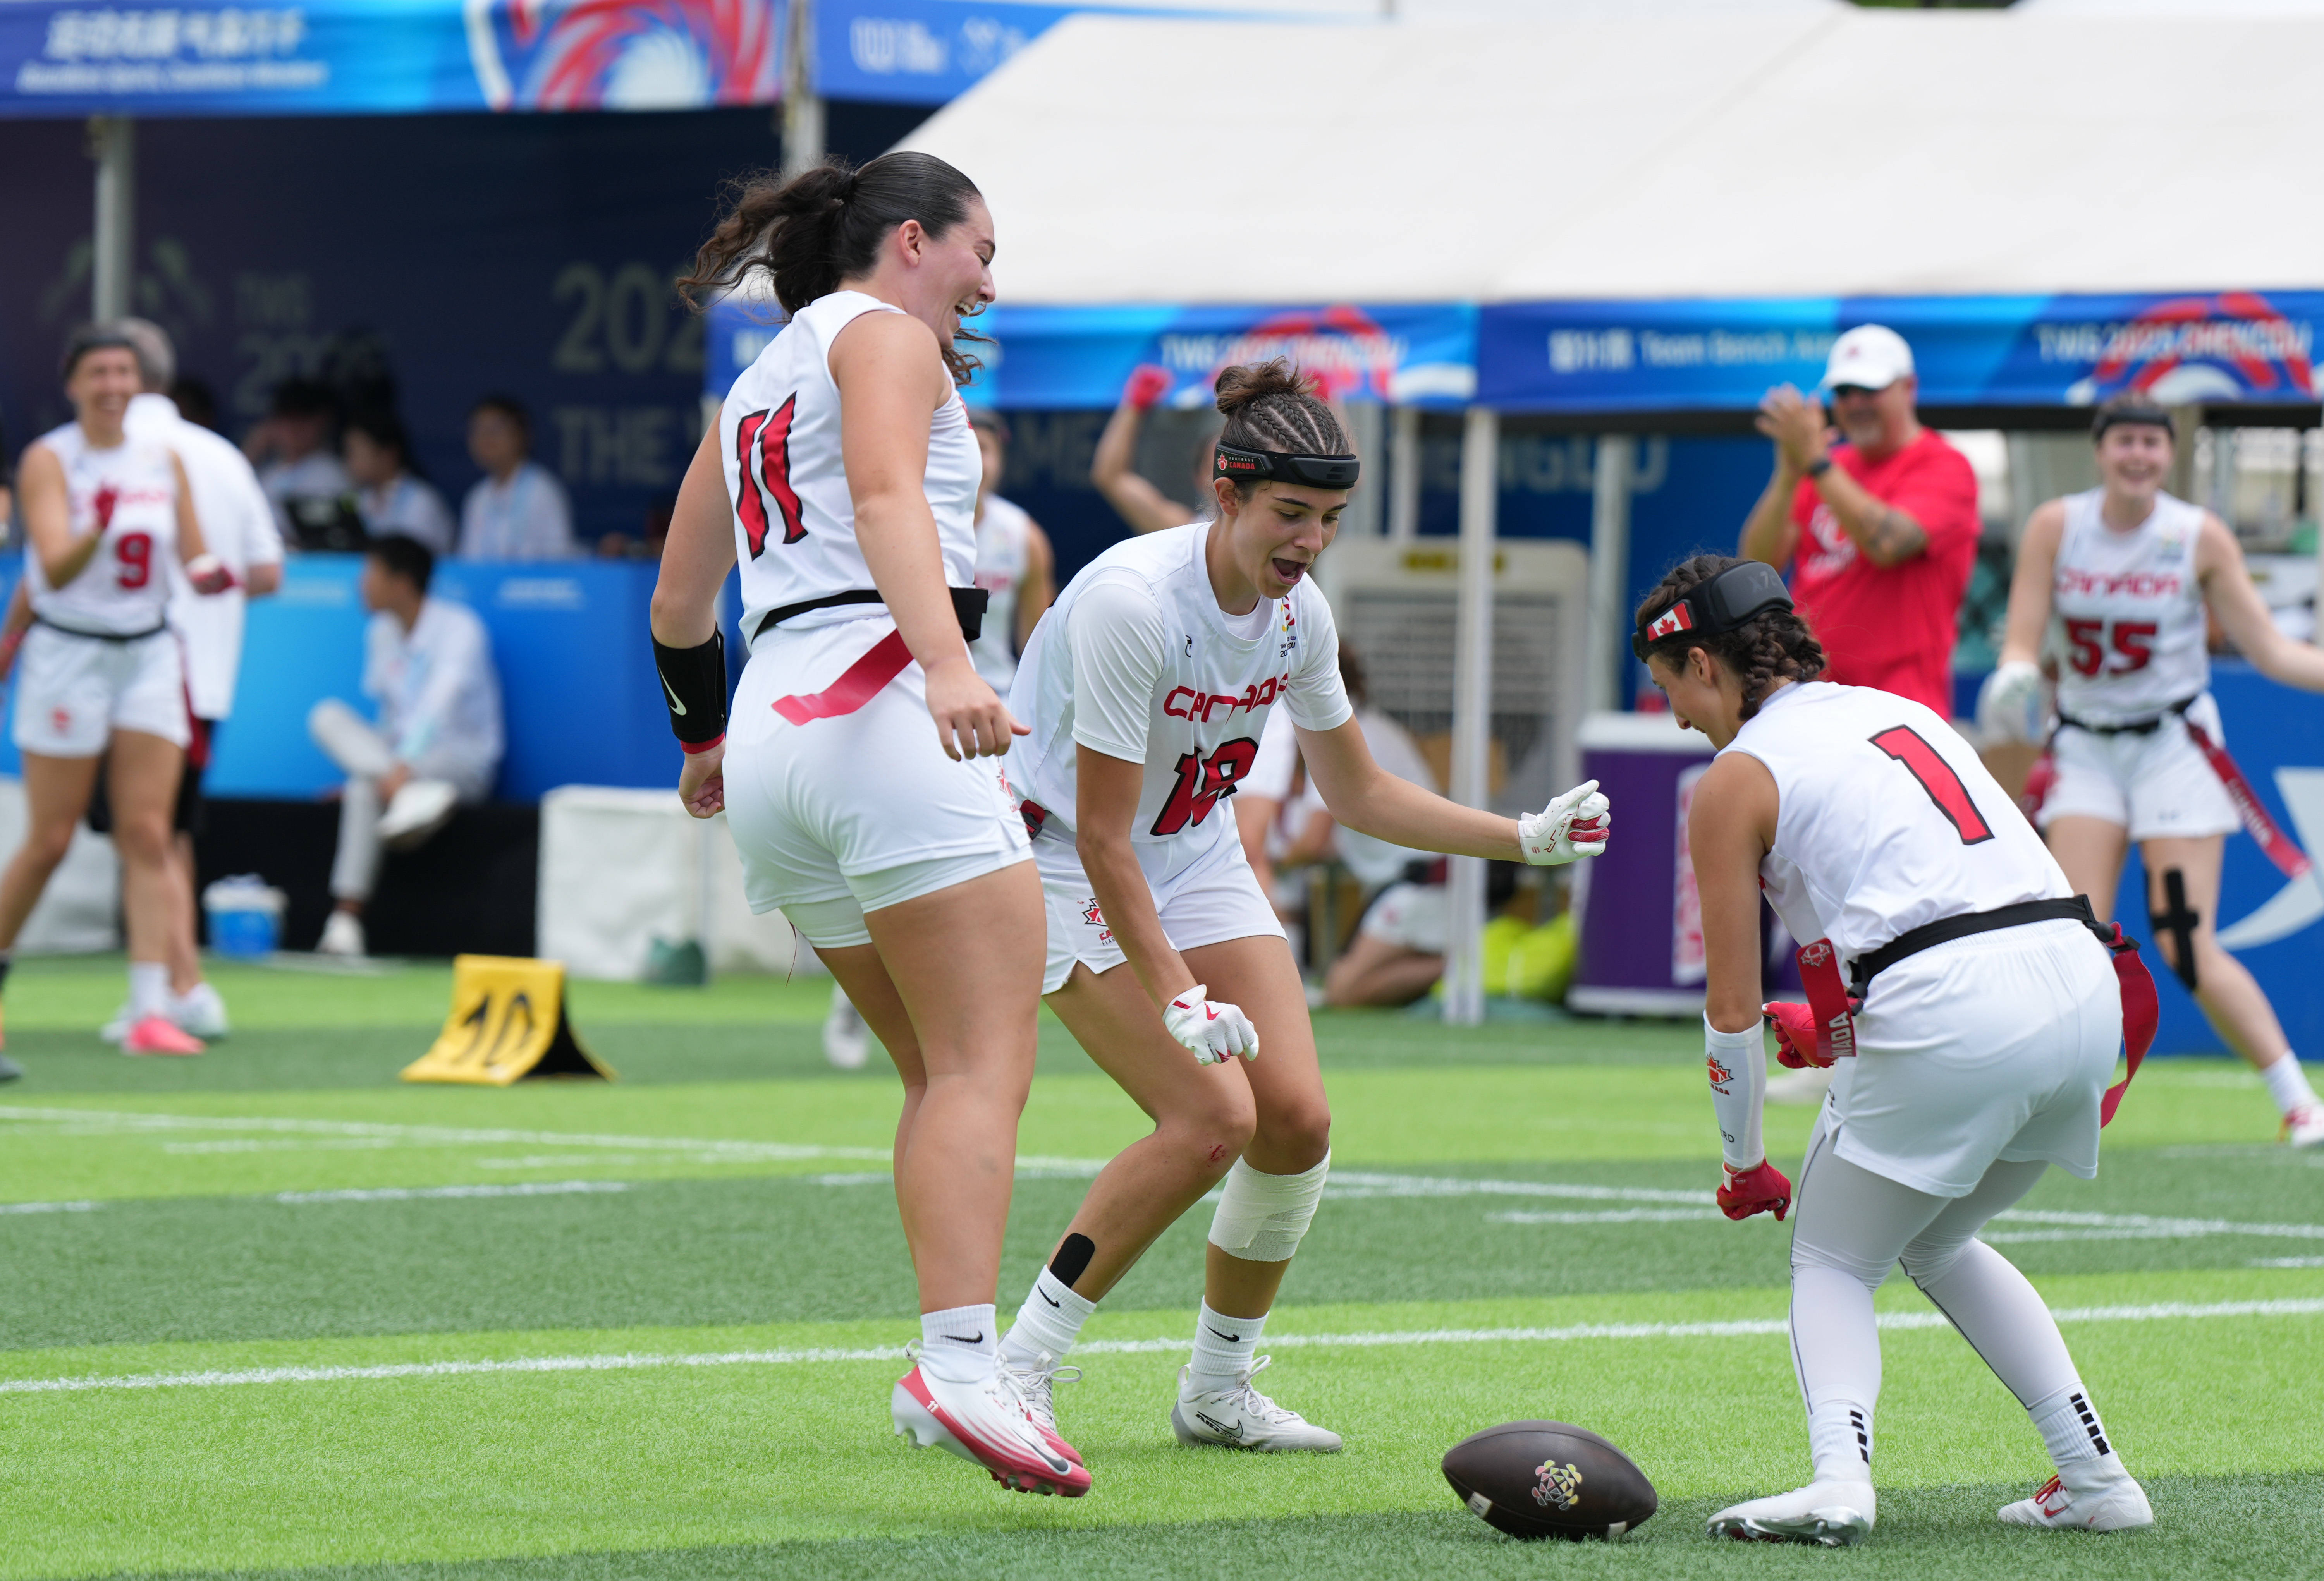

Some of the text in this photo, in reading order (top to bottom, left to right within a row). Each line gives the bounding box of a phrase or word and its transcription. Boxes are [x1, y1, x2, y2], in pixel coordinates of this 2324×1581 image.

[736, 390, 809, 562] 11
[1229, 461, 1255, 470] CANADA
[114, 532, 153, 589] 9
[2064, 618, 2158, 680] 55
[1867, 724, 1995, 845] 1
[927, 1400, 939, 1413] 11
[1195, 1413, 1220, 1433] AIR
